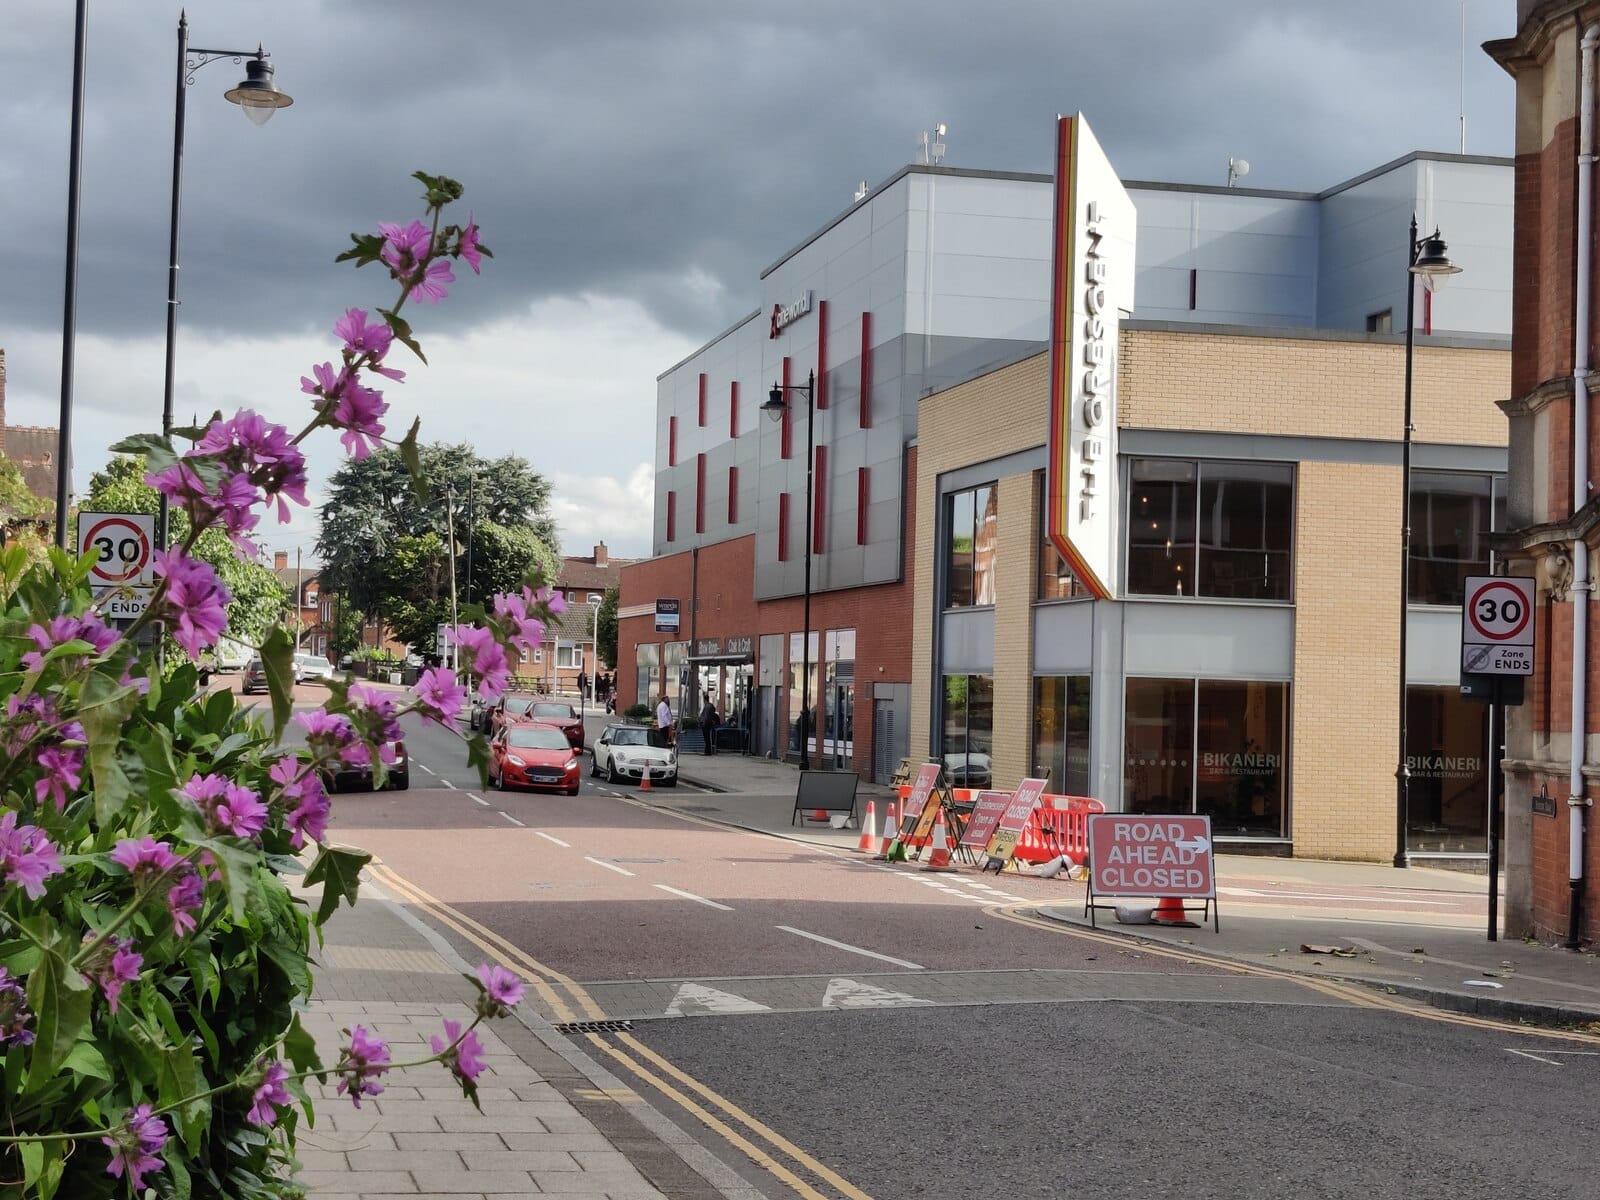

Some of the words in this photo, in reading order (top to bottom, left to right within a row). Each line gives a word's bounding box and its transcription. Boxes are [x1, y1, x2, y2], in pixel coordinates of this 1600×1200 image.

[1084, 200, 1106, 428] CRESCENT
[1079, 438, 1104, 525] THE
[94, 537, 140, 562] 30
[1479, 599, 1521, 623] 30
[1501, 650, 1524, 658] Zone
[1495, 660, 1530, 669] ENDS
[1204, 753, 1280, 767] BIKANERI
[1407, 756, 1480, 771] BIKANERI
[1006, 804, 1030, 819] CLOSED
[1114, 823, 1185, 841] ROAD
[1107, 846, 1196, 865] AHEAD
[1101, 868, 1203, 888] CLOSED
